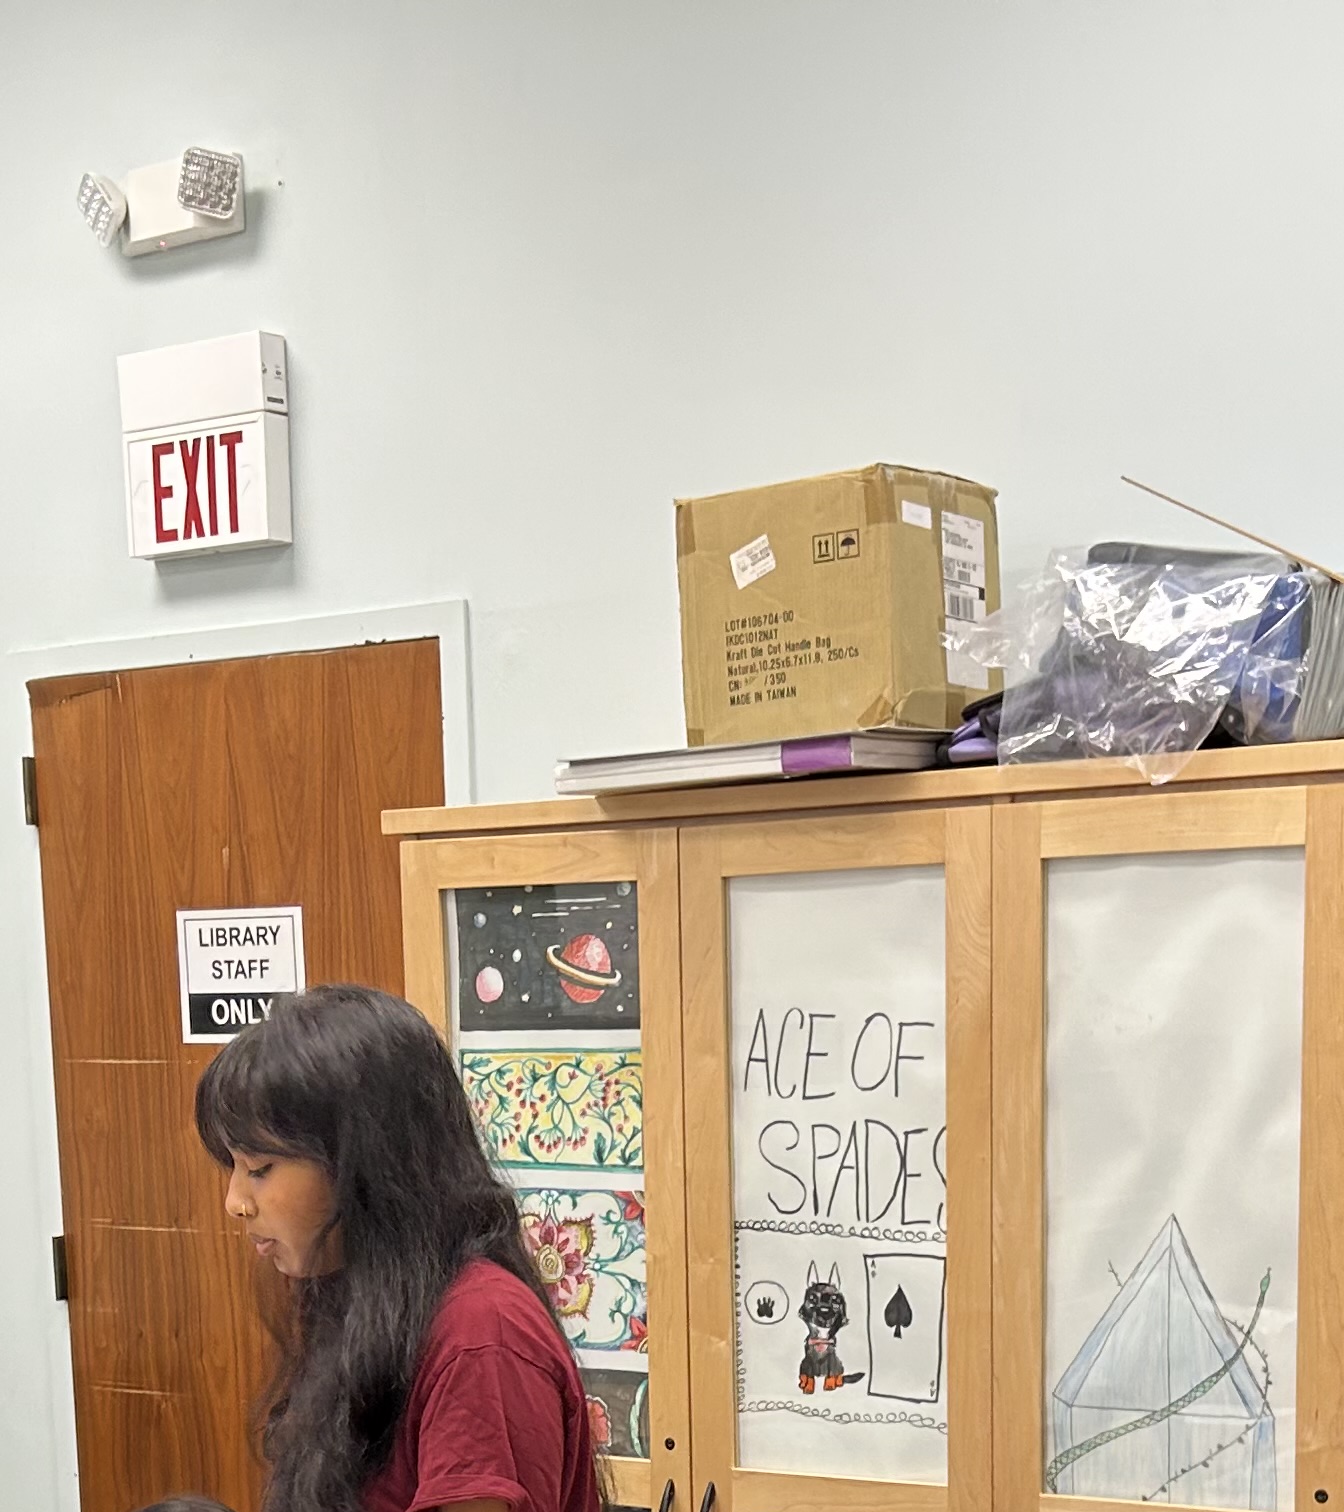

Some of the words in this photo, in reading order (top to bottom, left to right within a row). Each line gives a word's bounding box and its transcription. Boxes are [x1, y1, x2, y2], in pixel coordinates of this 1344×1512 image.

[151, 430, 243, 543] EXIT
[727, 649, 747, 662] Kraft
[768, 643, 781, 655] Cut
[730, 693, 751, 706] MADE
[755, 692, 762, 703] IN
[767, 686, 796, 701] TAIWAN
[199, 925, 281, 947] LIBRARY
[211, 959, 270, 980] STAFF
[211, 998, 273, 1024] ONLY
[744, 1008, 836, 1100] ACE
[851, 1012, 935, 1098] OF
